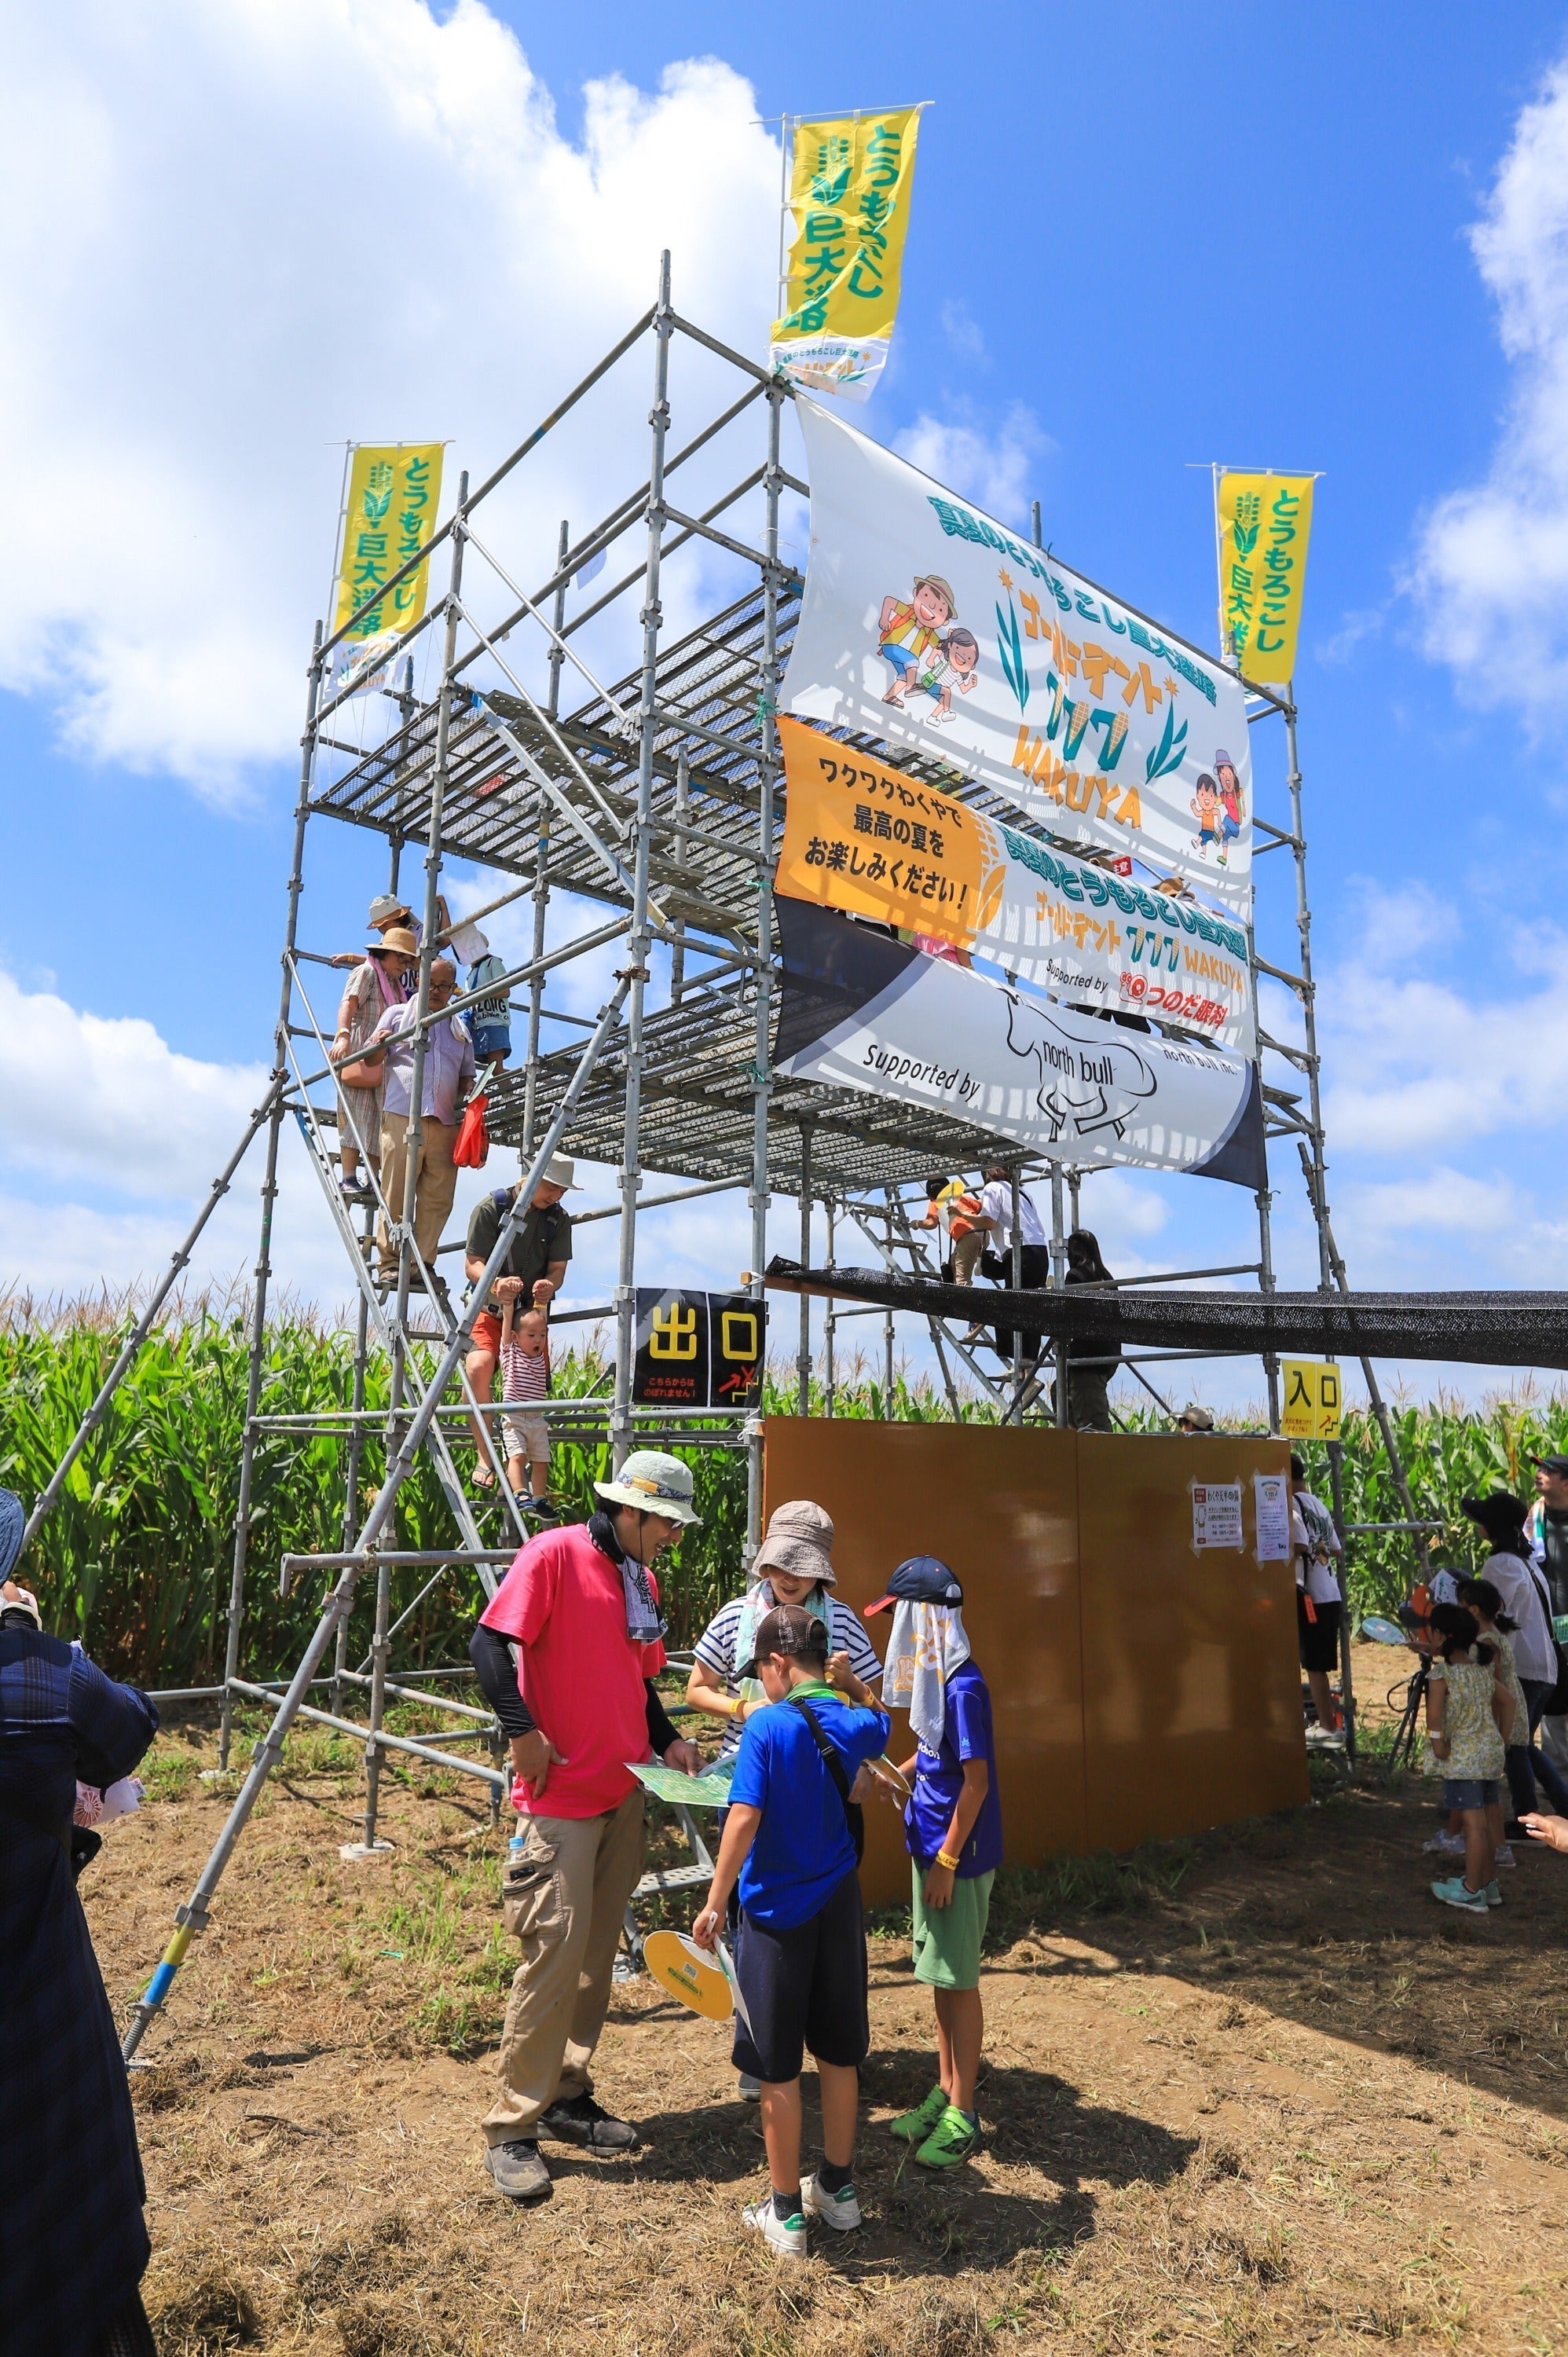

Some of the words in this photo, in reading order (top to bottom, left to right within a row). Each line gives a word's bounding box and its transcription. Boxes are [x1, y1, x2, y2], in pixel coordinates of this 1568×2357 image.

[1257, 489, 1300, 653] とうもろこし
[1046, 670, 1129, 772] 777
[819, 758, 962, 829] ワクワクわくやで
[1012, 724, 1141, 829] WAKUYA
[853, 803, 944, 859] 最高の夏を
[804, 836, 967, 910] お楽しみください！
[998, 826, 1247, 966] 真夏のとうもろこし巨大迷
[1046, 958, 1091, 988] Supported
[1094, 975, 1109, 994] by
[1184, 945, 1244, 995] WAKUYA
[1145, 986, 1229, 1029] つのだ眼科
[863, 1044, 959, 1090] Supported
[958, 1072, 981, 1102] by
[1042, 1040, 1075, 1079] north
[1079, 1051, 1114, 1086] bull
[1163, 1050, 1195, 1065] north
[1194, 1054, 1219, 1071] bull
[650, 1302, 757, 1361] 出口
[648, 1376, 694, 1387] こちらからは
[1288, 1370, 1337, 1408] 入口
